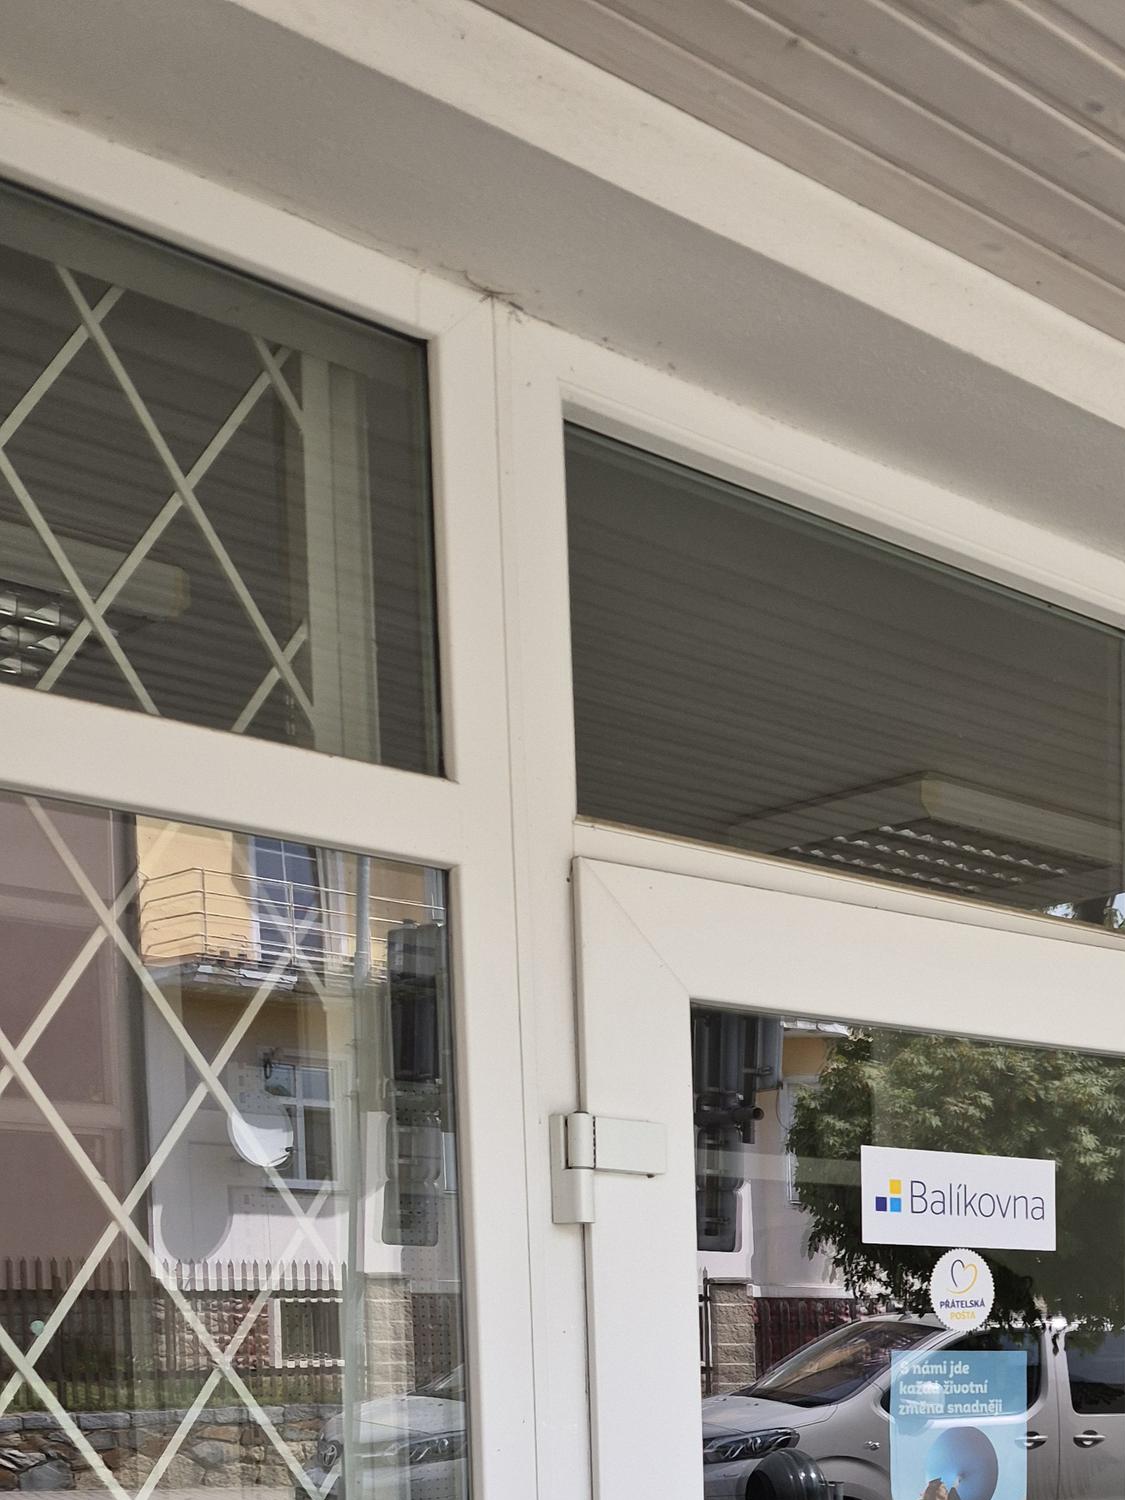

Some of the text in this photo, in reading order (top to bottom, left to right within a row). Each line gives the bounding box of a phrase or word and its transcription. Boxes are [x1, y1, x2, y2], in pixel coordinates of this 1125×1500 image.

[910, 1180, 1045, 1220] Balíkovna
[939, 1298, 986, 1310] PŘÁTELSKÁ
[950, 1310, 976, 1320] POŠTA
[913, 1361, 947, 1375] námi
[949, 1361, 970, 1378] jde
[943, 1379, 988, 1394] životní
[947, 1398, 1003, 1416] snadněji
